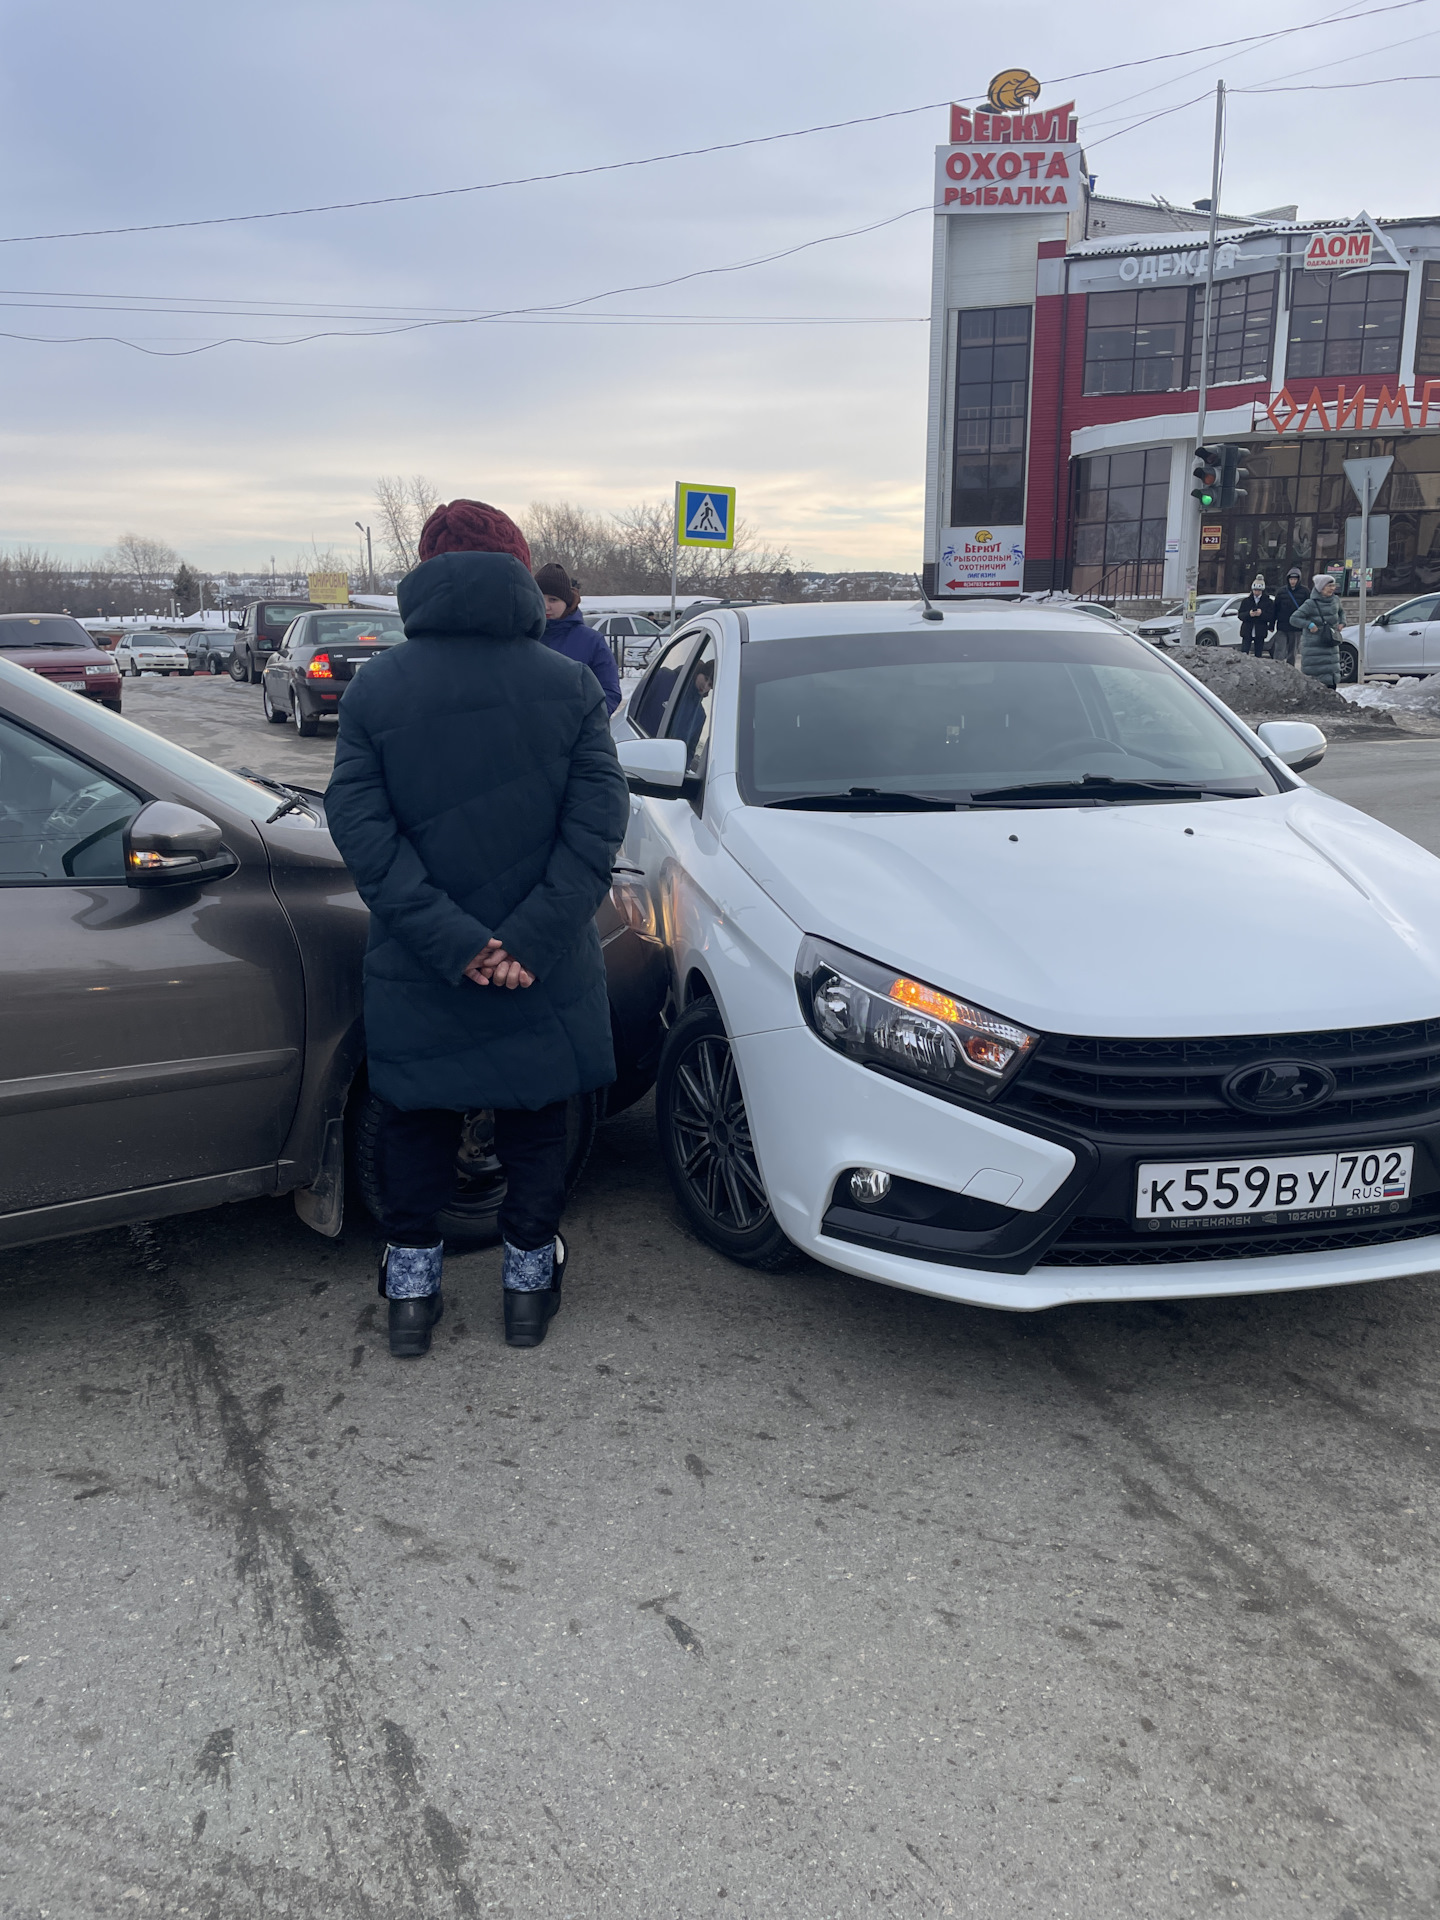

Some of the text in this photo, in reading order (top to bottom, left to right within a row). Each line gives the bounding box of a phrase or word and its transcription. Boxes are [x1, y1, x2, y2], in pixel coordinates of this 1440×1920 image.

[950, 100, 1075, 142] БЕРКУТ
[945, 151, 1070, 180] ОХОТА
[944, 185, 1068, 206] РЫБАЛКА
[1307, 235, 1371, 258] ДОМ
[965, 542, 1001, 553] БЕРКУТ
[1150, 1152, 1402, 1213] К559ВУ 702
[1352, 1186, 1382, 1199] RUS
[1170, 1215, 1251, 1229] NEFTEKAMSK
[1288, 1208, 1337, 1222] 102AUTO
[1346, 1204, 1380, 1216] 2-11-12
